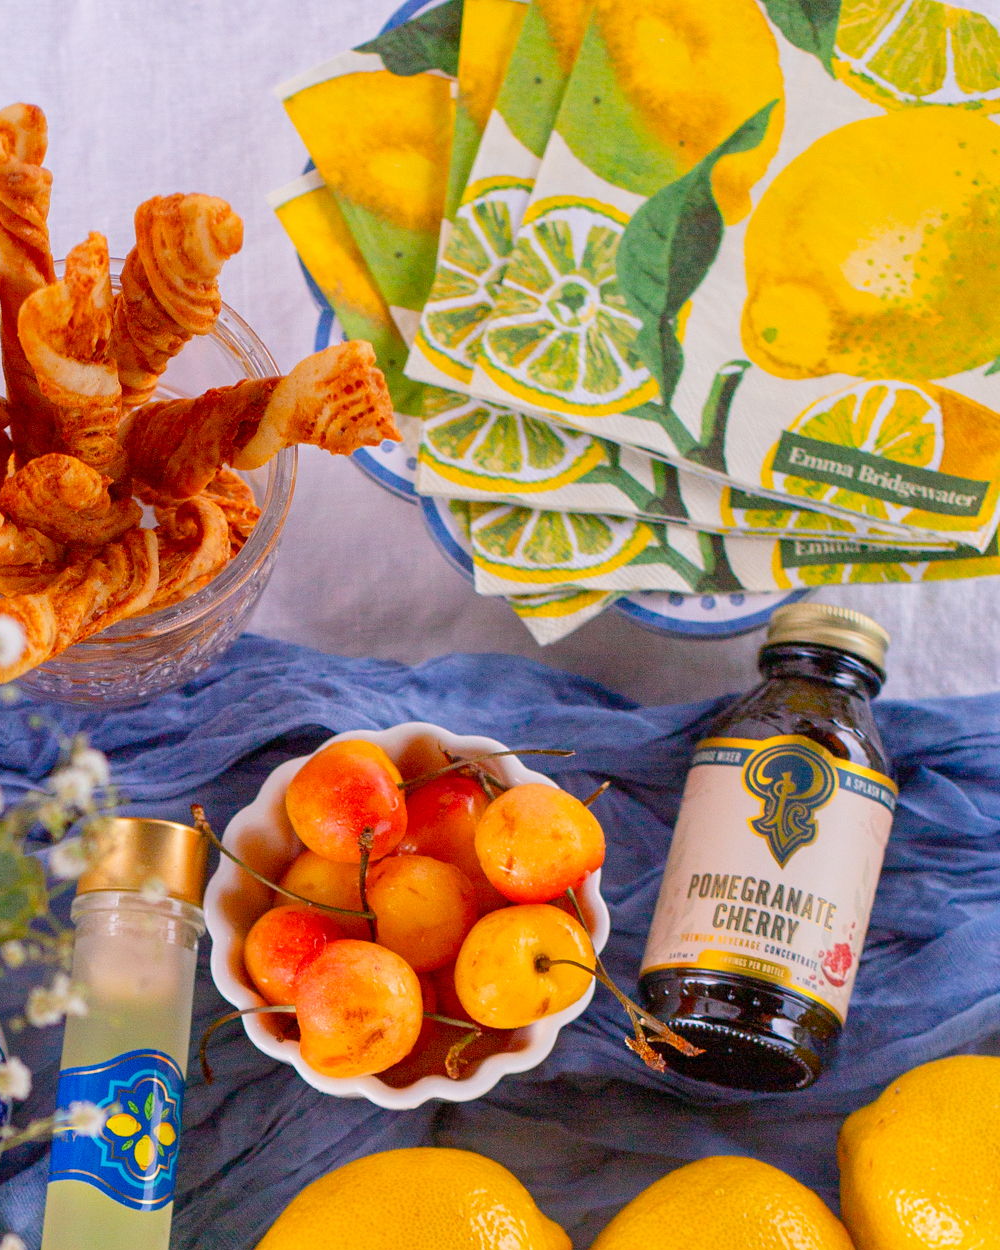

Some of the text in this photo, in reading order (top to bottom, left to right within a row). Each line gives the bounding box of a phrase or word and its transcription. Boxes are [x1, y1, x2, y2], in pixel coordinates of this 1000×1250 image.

[788, 446, 978, 507] Emma Bridgewater
[687, 872, 837, 931] POMEGRANATE
[712, 902, 800, 945] CHERRY
[764, 943, 818, 971] CONCENTRATE
